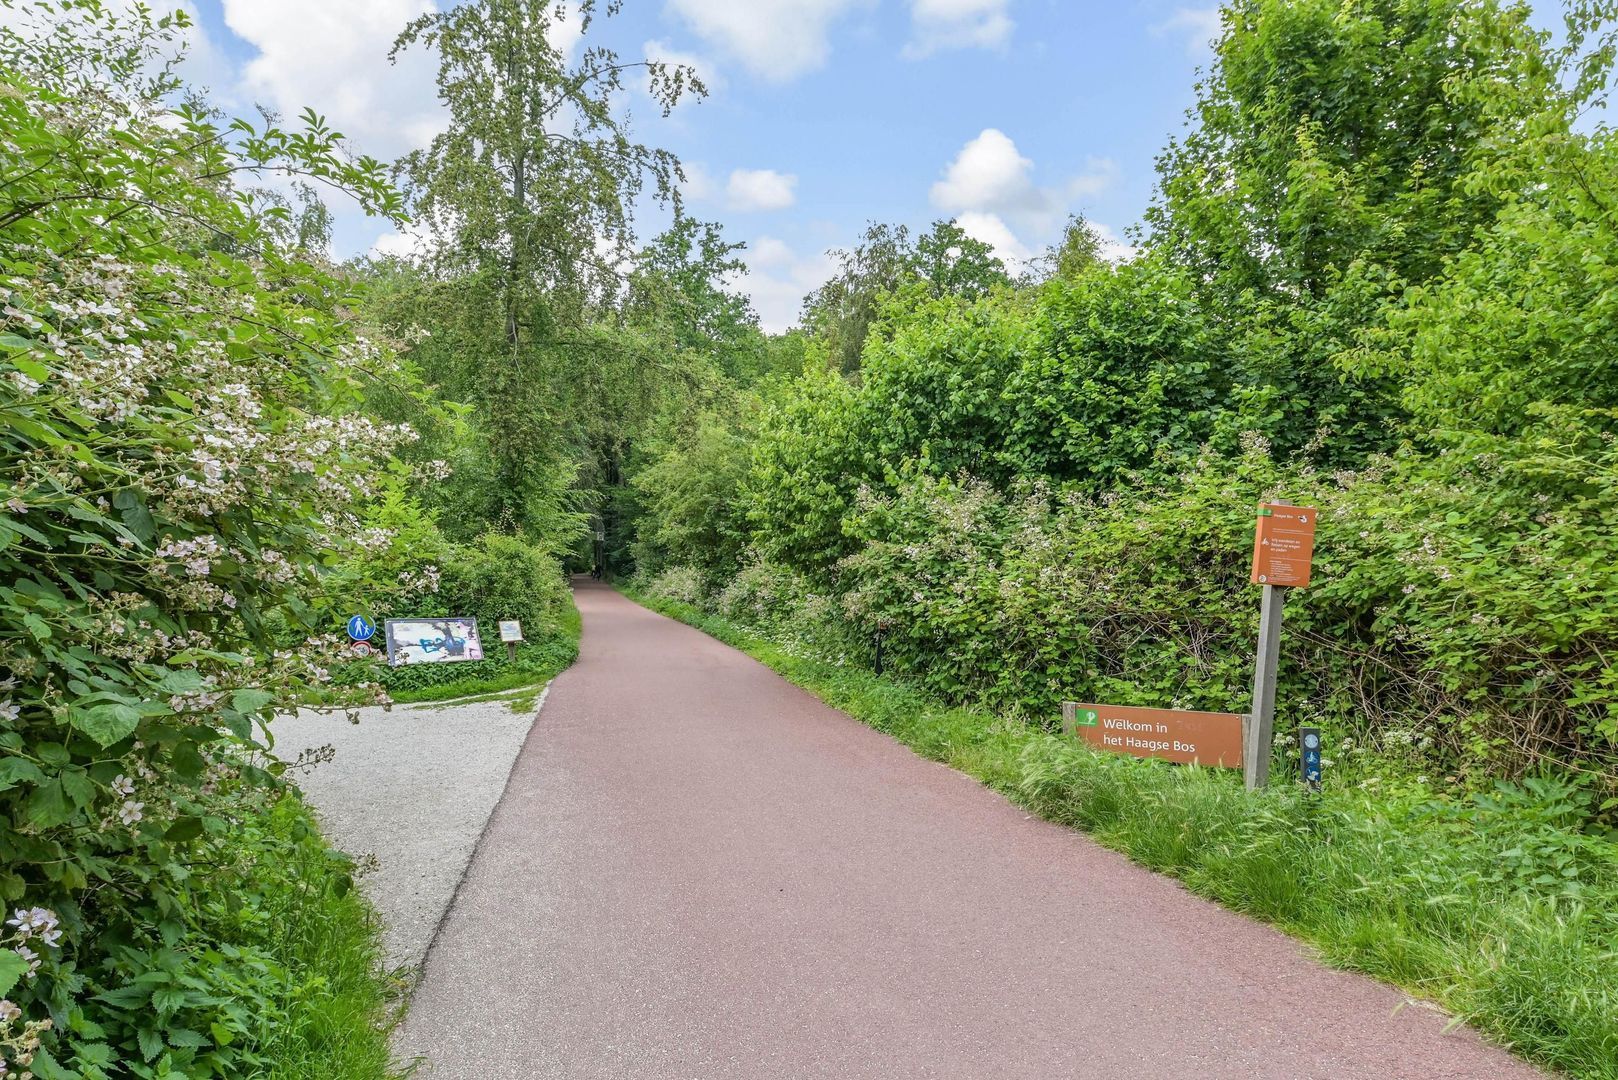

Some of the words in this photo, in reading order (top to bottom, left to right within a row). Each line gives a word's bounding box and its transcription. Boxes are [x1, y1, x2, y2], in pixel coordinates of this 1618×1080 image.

[1103, 719, 1152, 732] Welkom
[1156, 722, 1168, 733] in
[1103, 734, 1122, 746] het
[1126, 737, 1170, 751] Haagse
[1173, 741, 1196, 752] Bos
